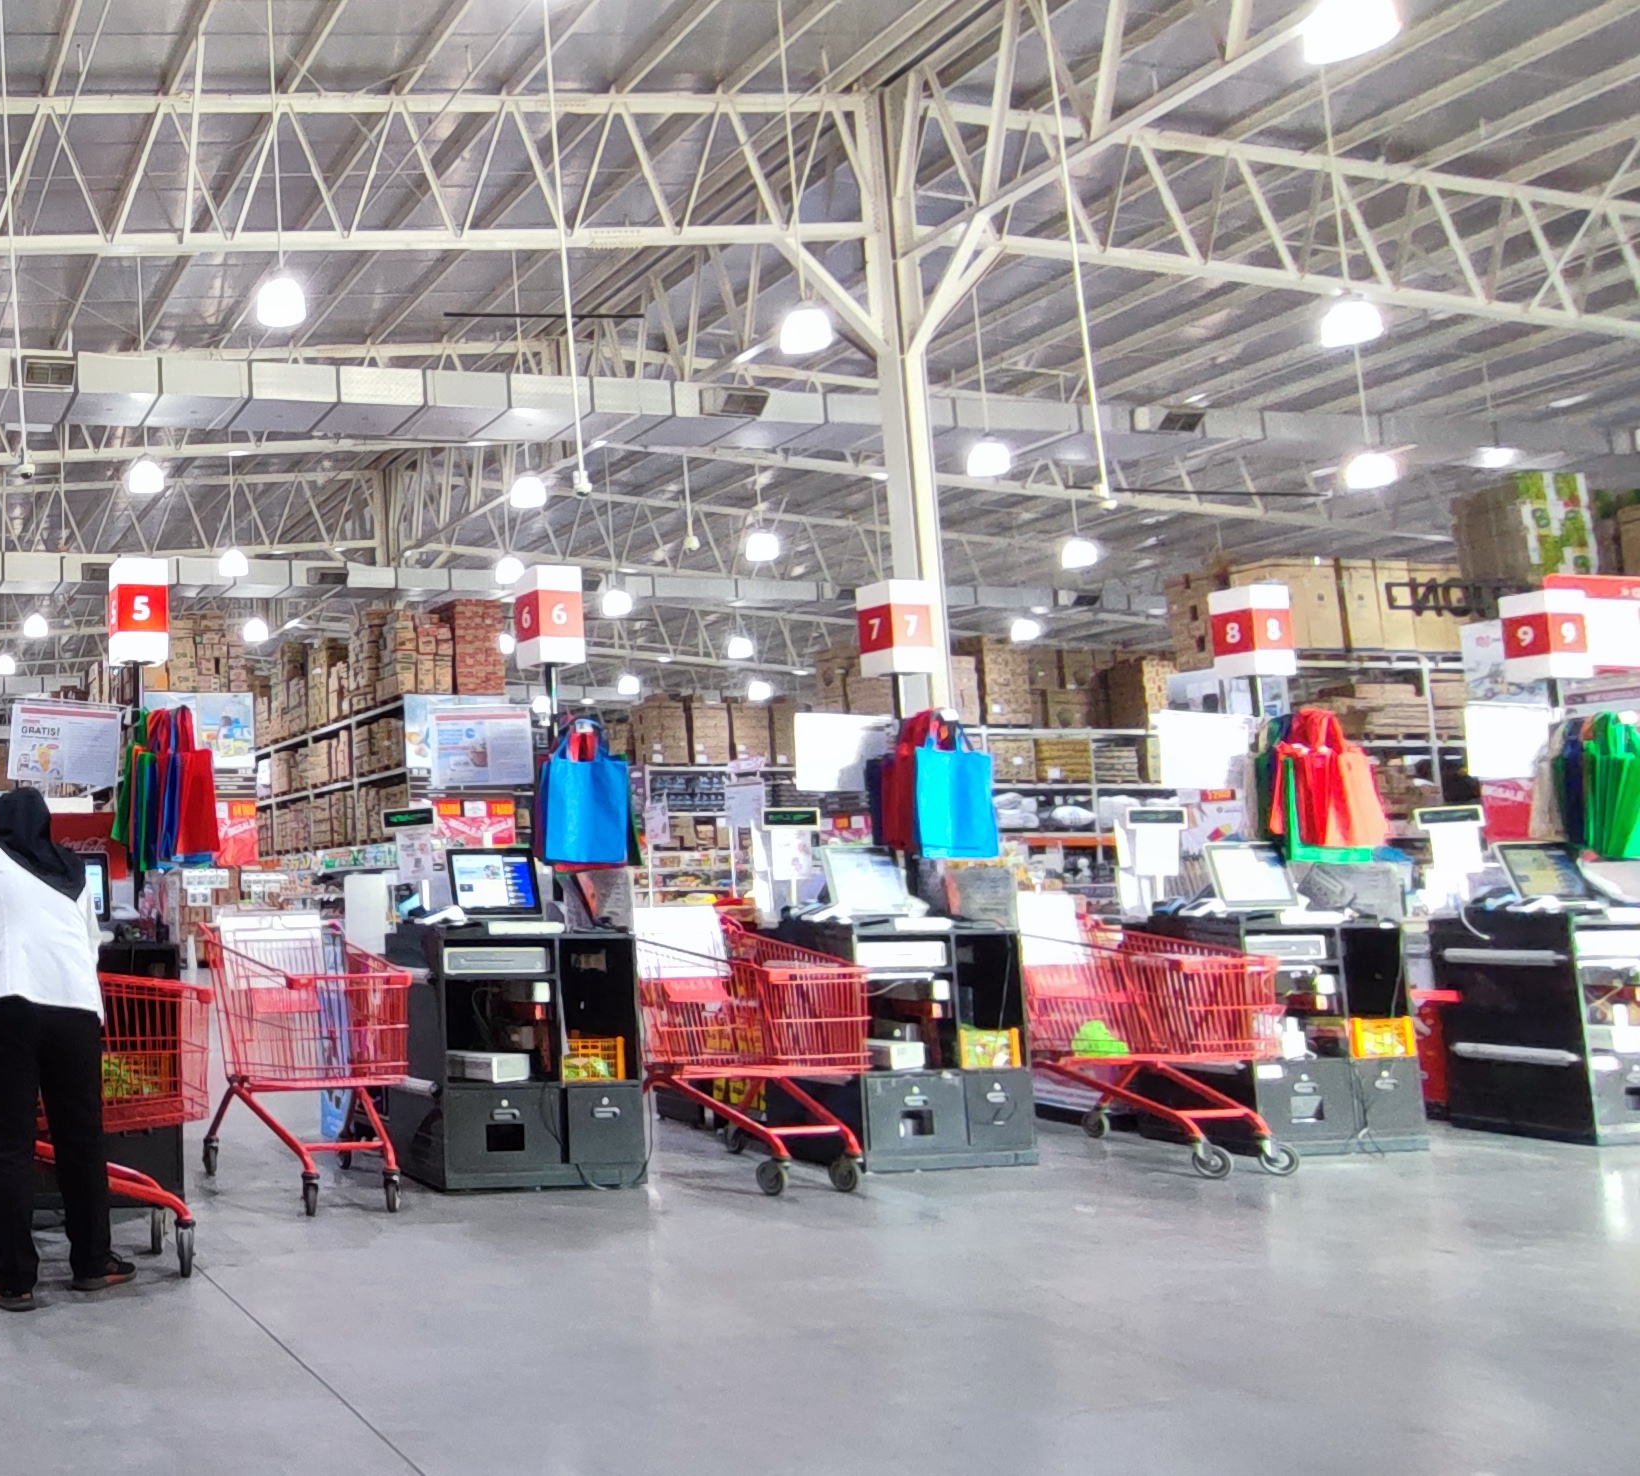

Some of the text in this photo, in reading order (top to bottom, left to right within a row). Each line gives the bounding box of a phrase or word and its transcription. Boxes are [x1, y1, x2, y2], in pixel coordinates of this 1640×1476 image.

[132, 595, 151, 621] 5
[521, 606, 531, 629] 6
[551, 603, 568, 625] 6
[868, 617, 881, 640] 7
[903, 614, 919, 638] 7
[1225, 622, 1241, 644] 8
[1266, 618, 1282, 641] 8
[1516, 625, 1535, 647] 9
[1560, 622, 1577, 644] 9
[21, 725, 60, 737] GRATIS!
